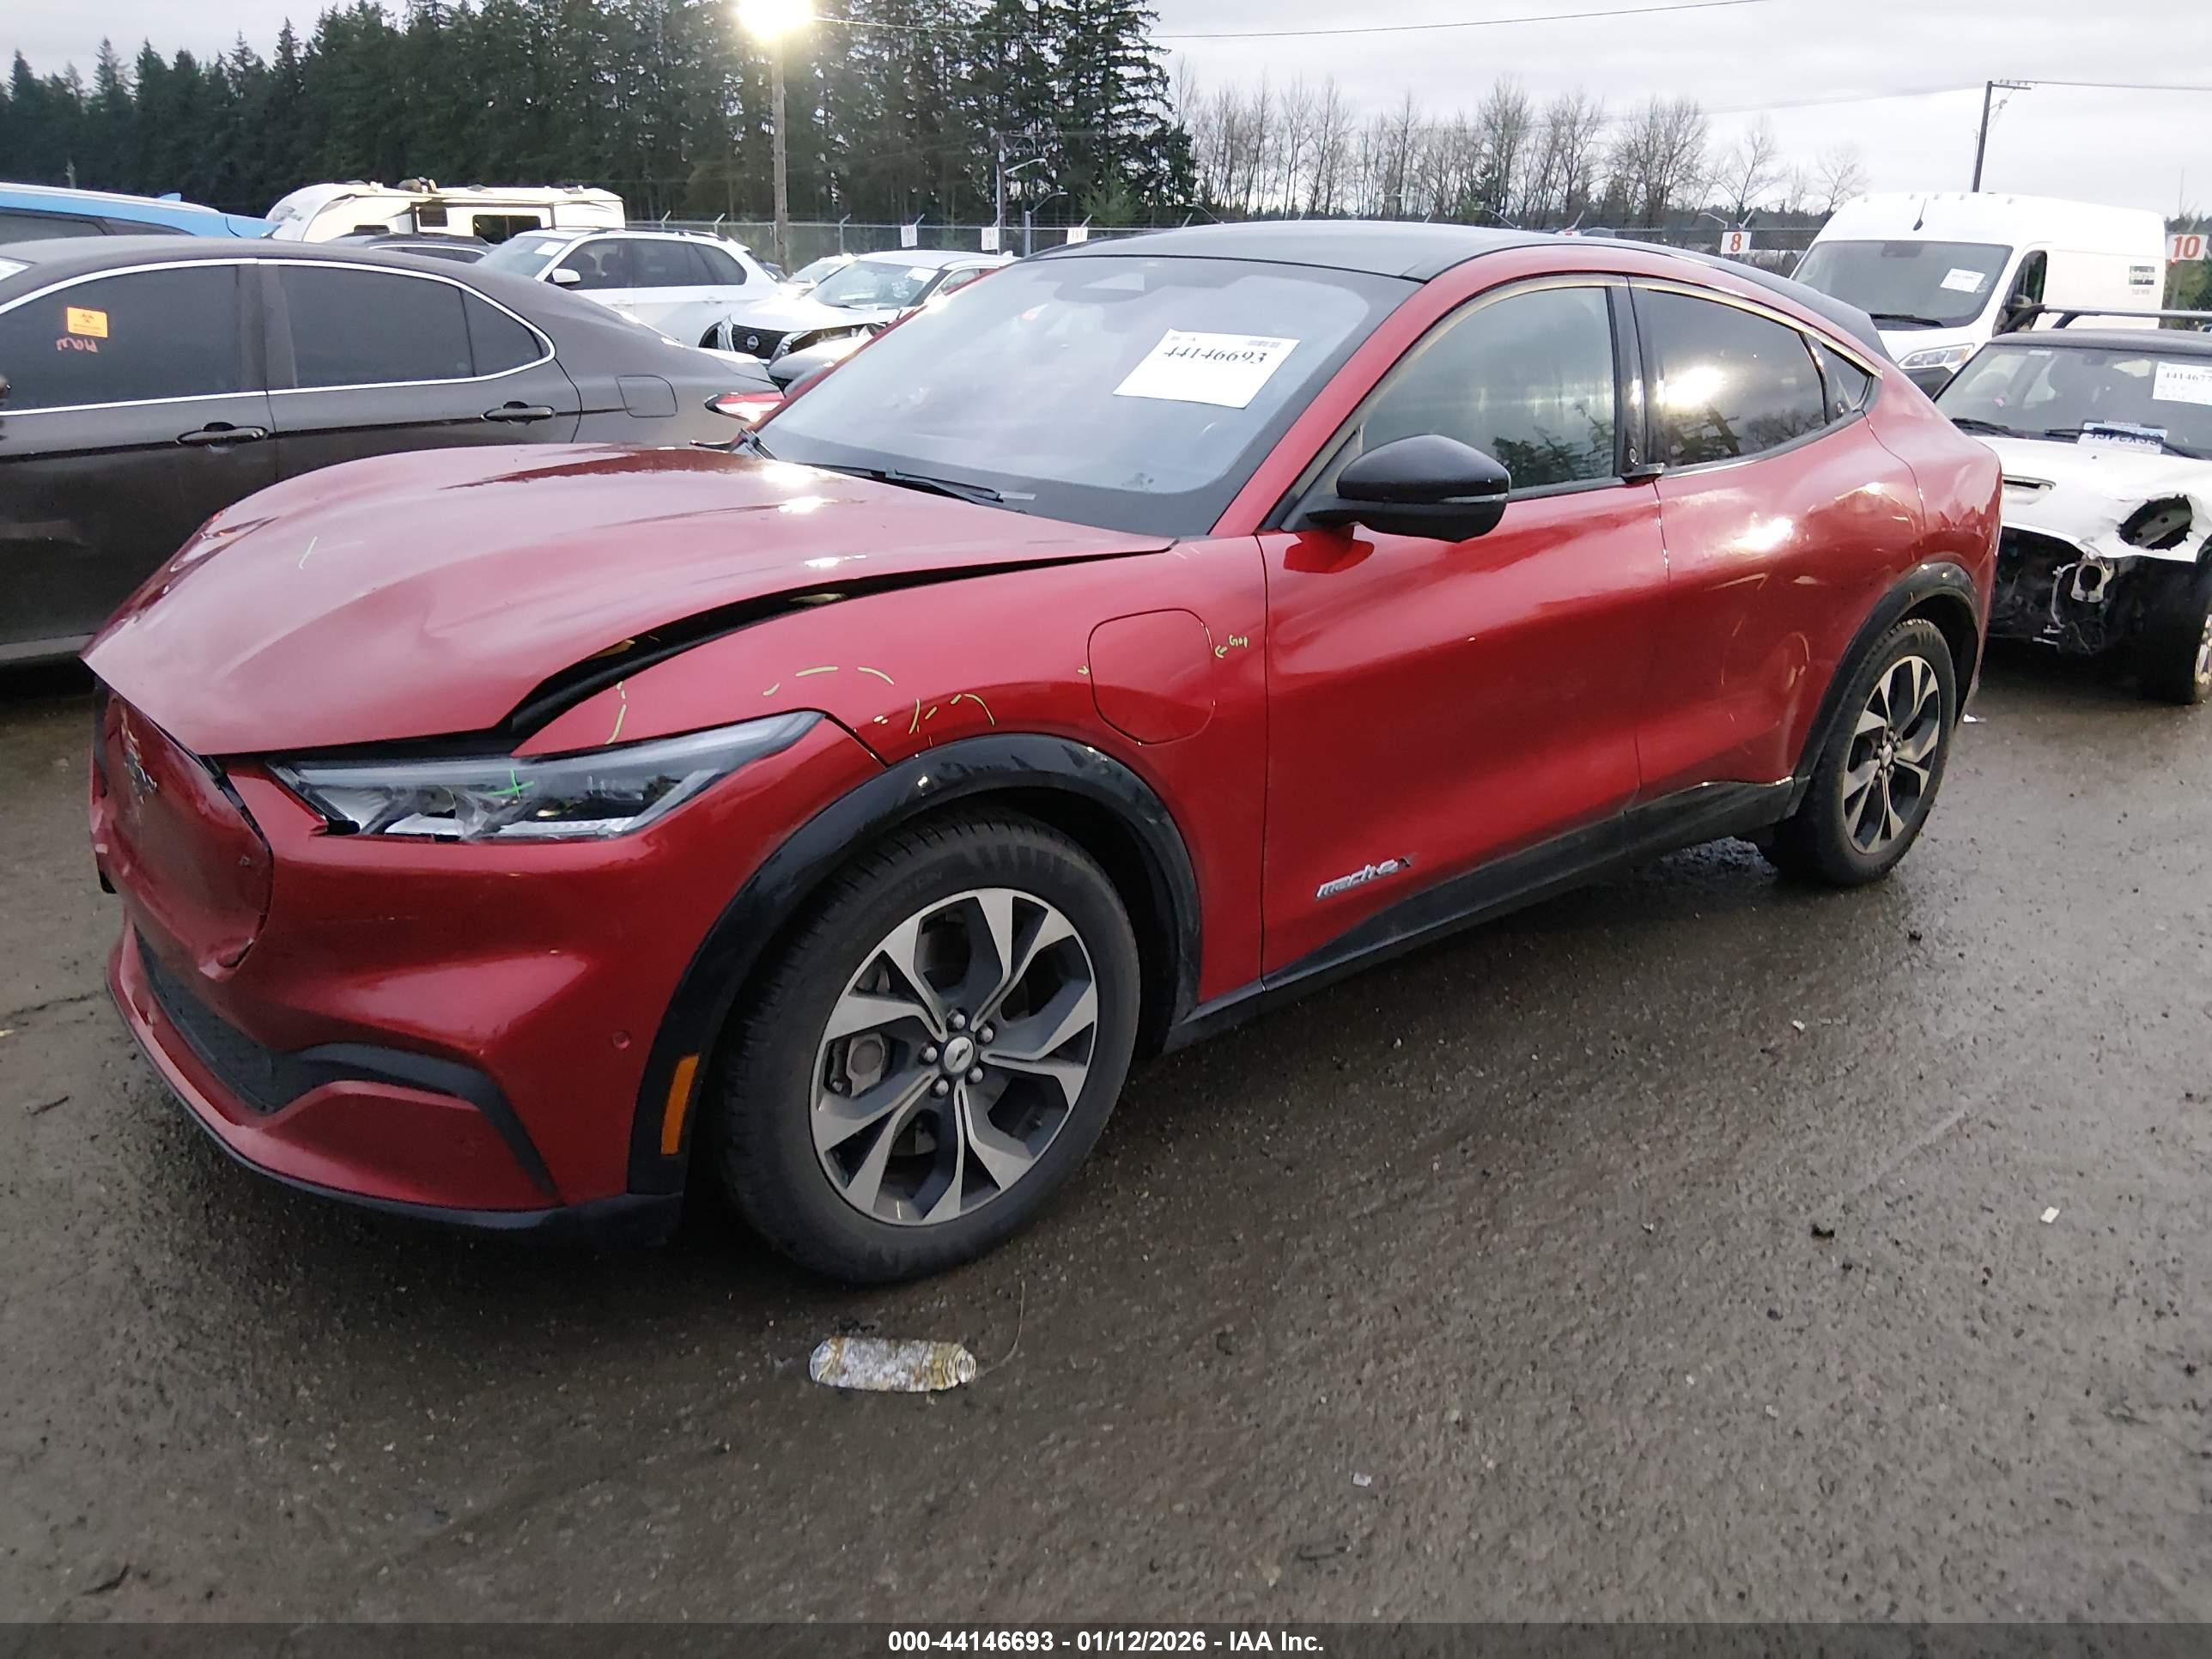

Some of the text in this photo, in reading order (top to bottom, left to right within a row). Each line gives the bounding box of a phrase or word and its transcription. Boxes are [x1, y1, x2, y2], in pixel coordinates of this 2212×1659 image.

[1730, 233, 1742, 252] 8
[2173, 235, 2201, 259] 10
[1163, 346, 1268, 364] 44146693
